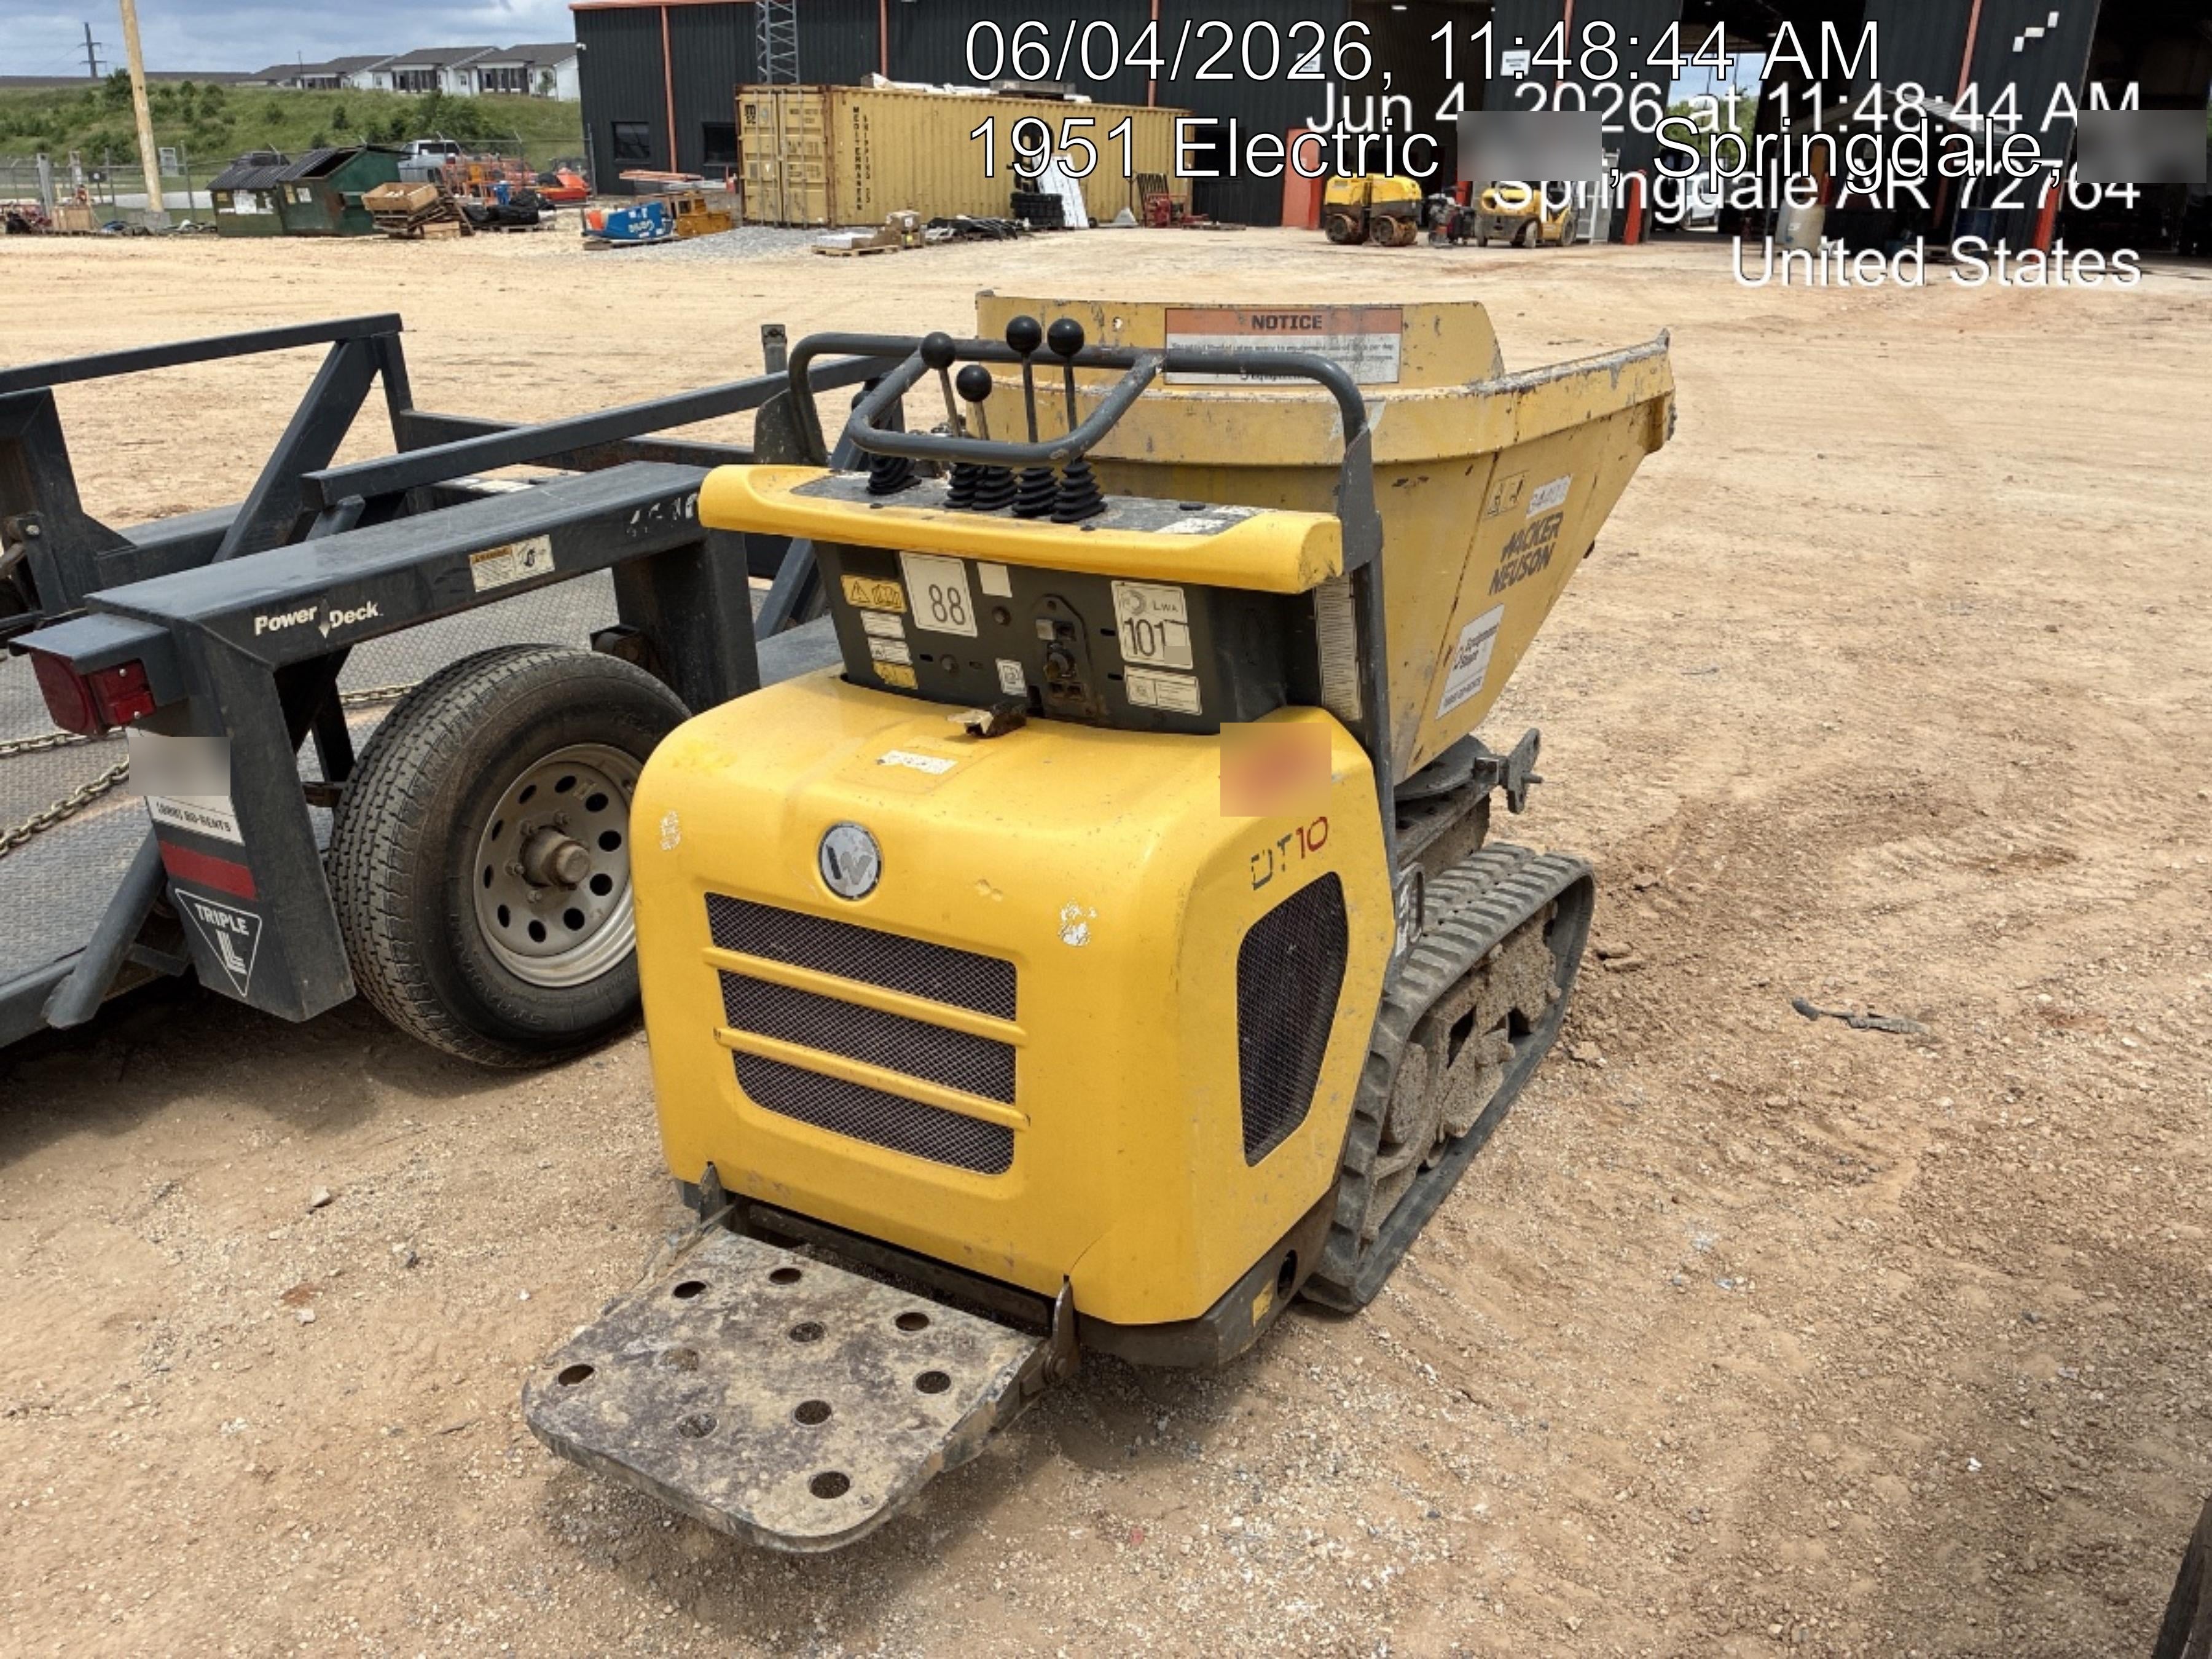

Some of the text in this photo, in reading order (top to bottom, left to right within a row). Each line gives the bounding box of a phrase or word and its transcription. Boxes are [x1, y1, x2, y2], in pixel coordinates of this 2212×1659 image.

[1252, 314, 1323, 330] NOTICE
[254, 600, 379, 635] Power Deck
[929, 584, 966, 626] 88
[1124, 617, 1166, 657] 101
[1250, 816, 1329, 891] DT10
[195, 902, 250, 936] TRIPLE
